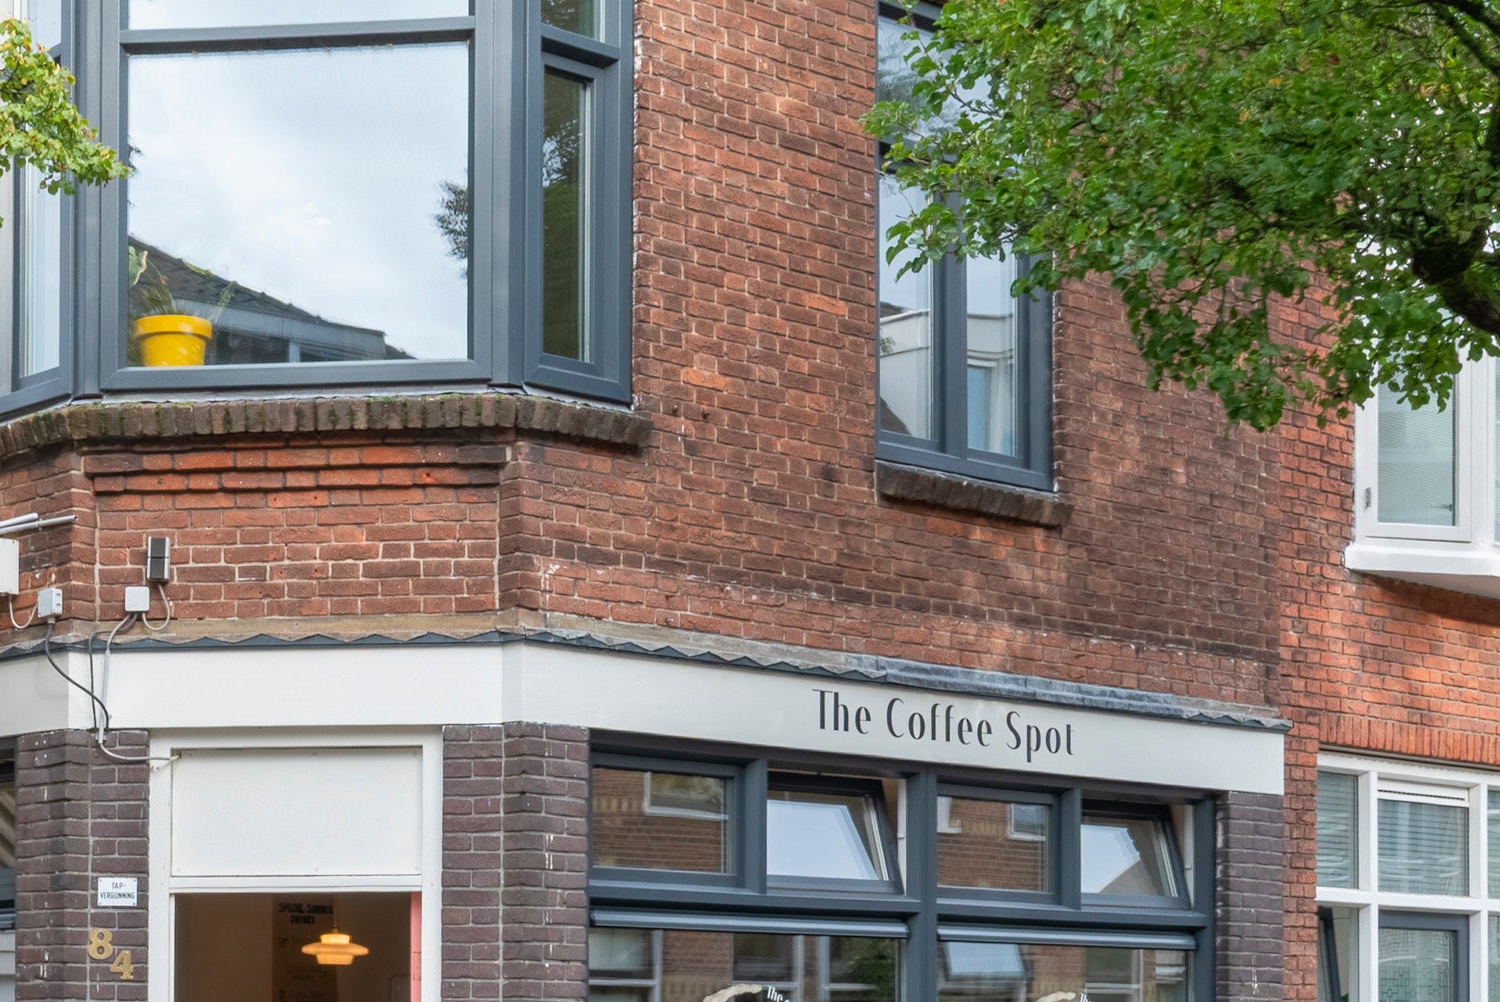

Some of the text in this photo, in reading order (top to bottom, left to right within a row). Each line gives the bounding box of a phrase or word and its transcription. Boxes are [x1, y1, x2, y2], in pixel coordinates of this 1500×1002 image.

[812, 688, 1075, 763] The Coffee Spot
[100, 892, 136, 900] VERGUNNING
